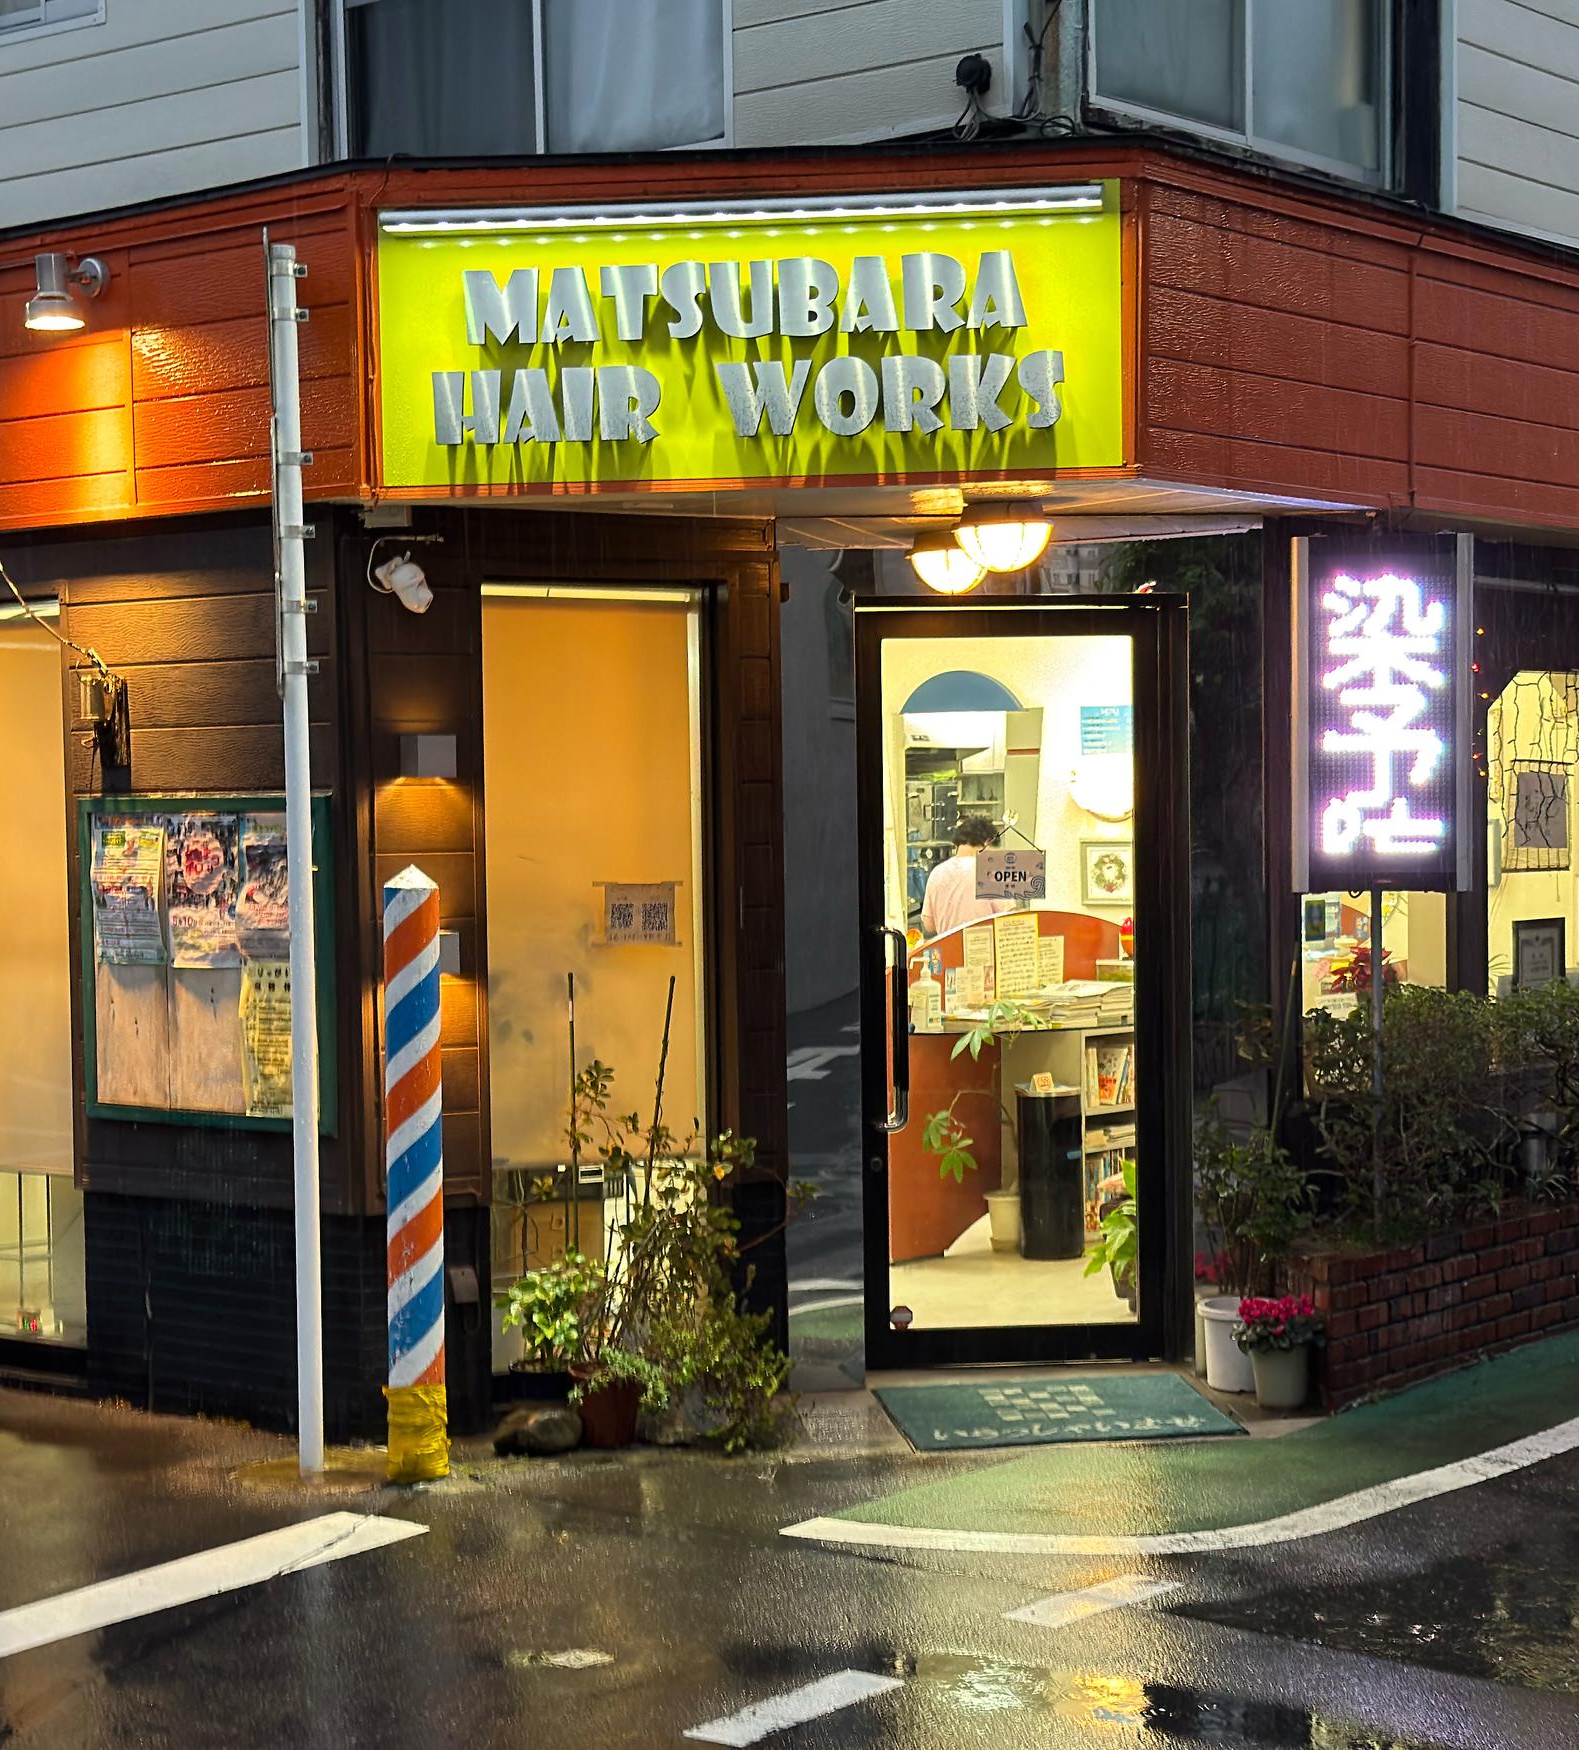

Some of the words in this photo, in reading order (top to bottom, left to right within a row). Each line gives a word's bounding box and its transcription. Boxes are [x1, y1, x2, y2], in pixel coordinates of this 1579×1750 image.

[461, 249, 1028, 346] MATSUBARA
[431, 364, 662, 446] HAIR
[715, 349, 1065, 438] WORKS
[994, 871, 1027, 882] OPEN
